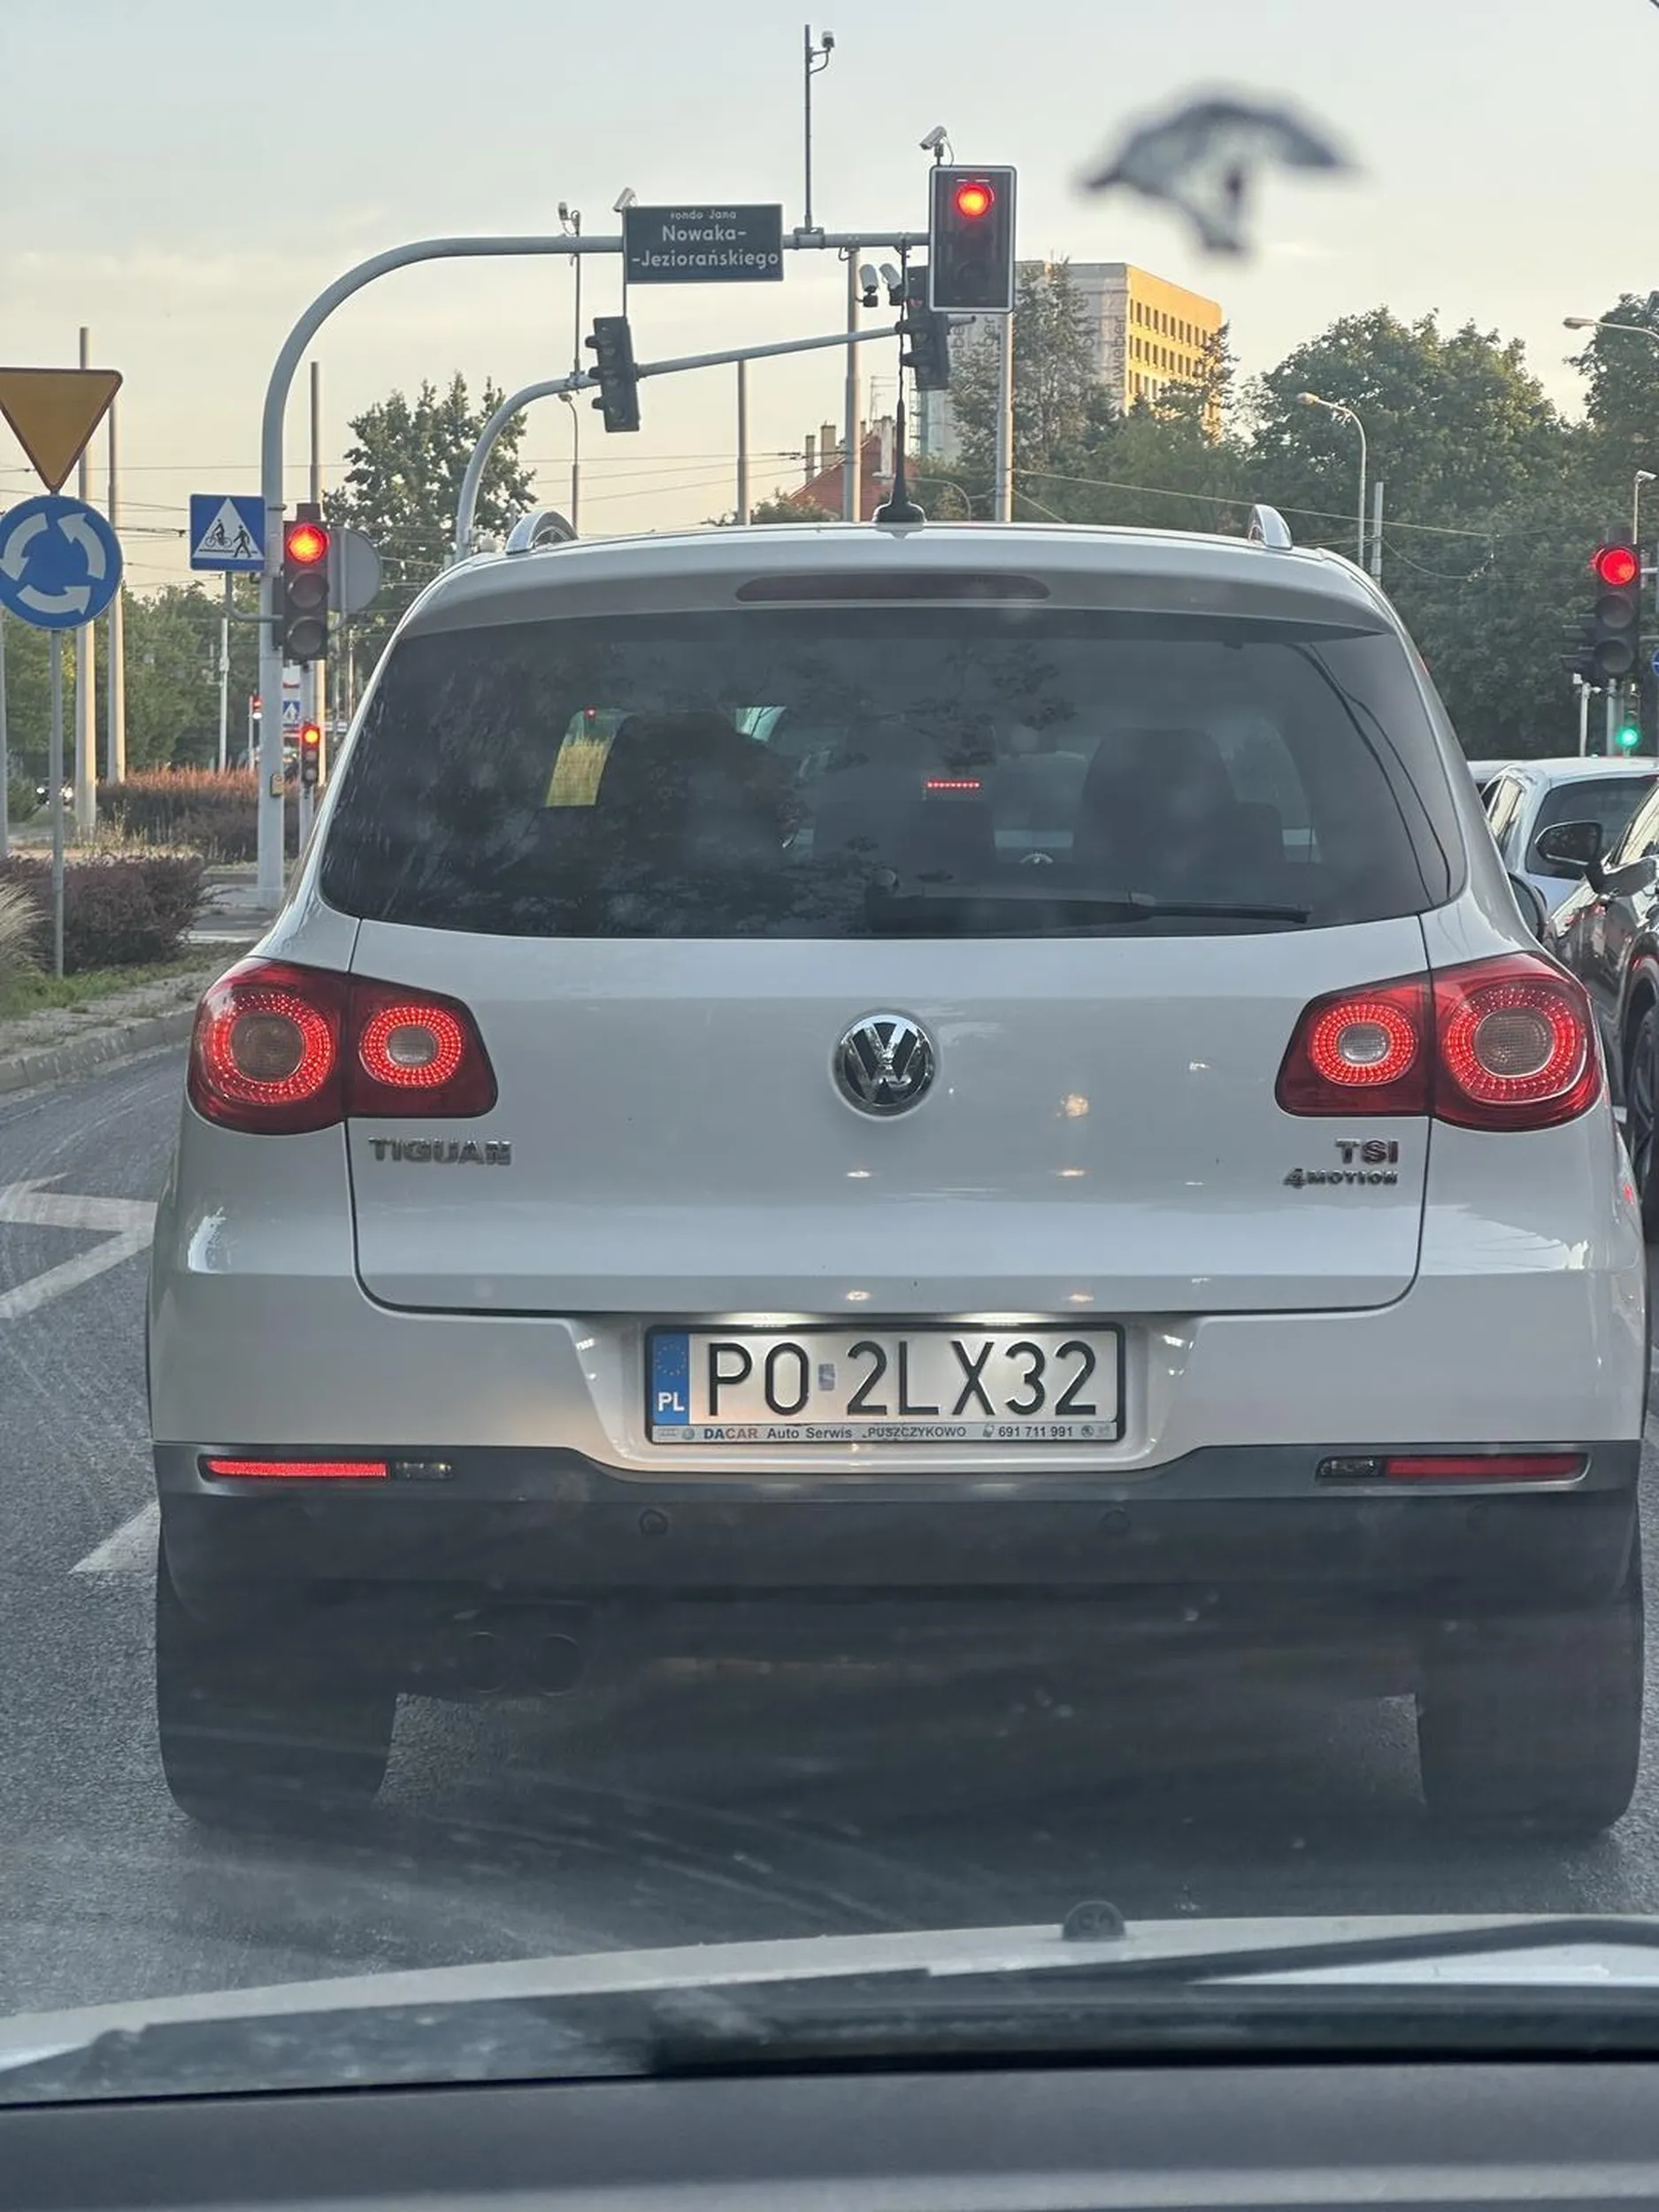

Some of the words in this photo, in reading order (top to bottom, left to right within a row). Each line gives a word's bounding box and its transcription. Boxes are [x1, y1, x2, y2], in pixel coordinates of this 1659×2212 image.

[670, 210, 703, 220] rondo
[709, 210, 737, 220] Jana
[662, 224, 748, 242] Nowaka-
[631, 249, 780, 270] -Jeziorańskiego
[368, 1137, 512, 1166] TIGUAN
[1335, 1138, 1399, 1164] TSI
[1283, 1167, 1399, 1189] 4MOTION
[709, 1341, 810, 1417] PO
[846, 1340, 1097, 1417] 2LX32
[657, 1392, 685, 1412] PL
[703, 1427, 759, 1440] DACAR
[767, 1427, 800, 1440] Auto
[805, 1426, 853, 1440] Serwis
[998, 1425, 1020, 1438] 691
[1025, 1425, 1047, 1438] 711
[1050, 1425, 1073, 1438] 991
